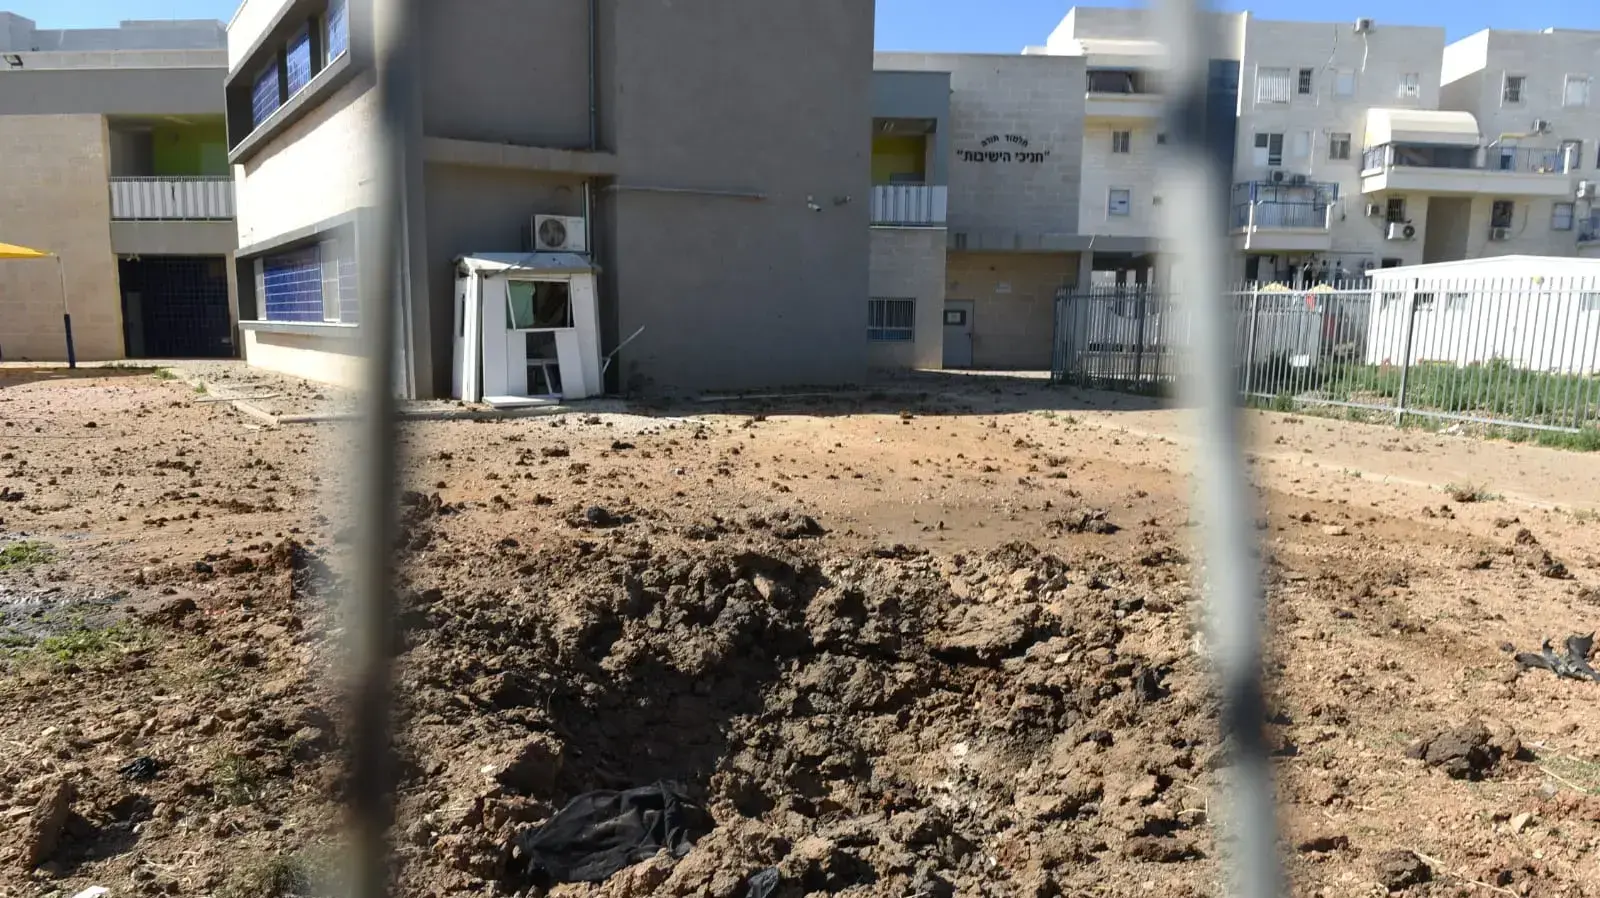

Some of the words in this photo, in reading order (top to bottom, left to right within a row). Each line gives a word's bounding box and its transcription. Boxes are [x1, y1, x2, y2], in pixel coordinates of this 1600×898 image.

[981, 135, 999, 147] תורה
[1005, 134, 1028, 148] תלמוד
[957, 150, 1011, 162] הישיבות"
[1015, 150, 1050, 162] "חניכי
